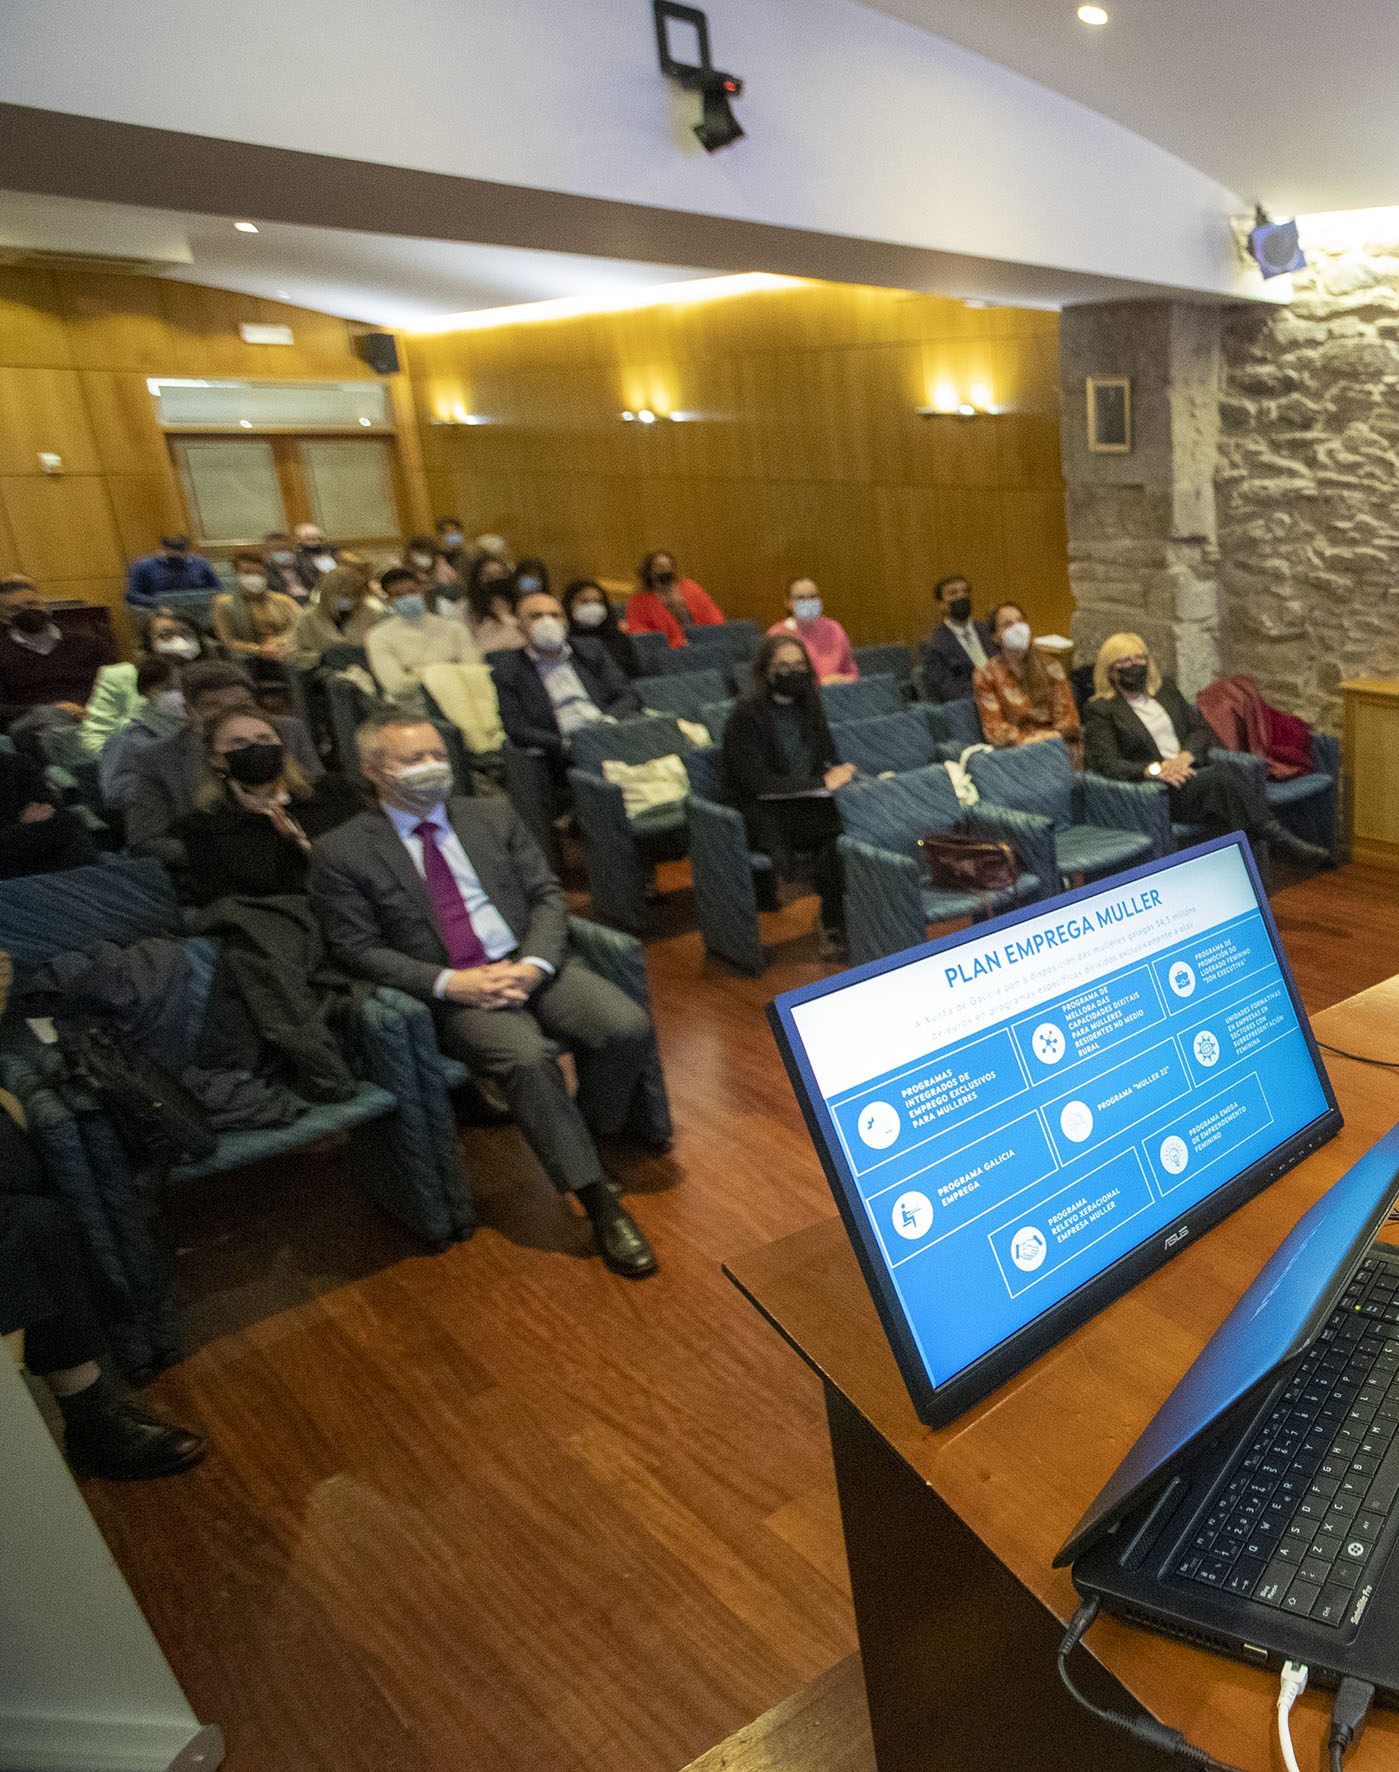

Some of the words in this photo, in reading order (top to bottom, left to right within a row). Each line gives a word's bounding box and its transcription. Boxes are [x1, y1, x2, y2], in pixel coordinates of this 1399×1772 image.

[944, 950, 1001, 988] PLAN
[1004, 915, 1095, 972] EMPREGA
[1095, 888, 1162, 929] MULLER
[1194, 943, 1224, 960] PROGRAMA
[1223, 939, 1232, 948] DE
[1197, 950, 1229, 968] PROMOCIÓN
[1228, 945, 1237, 954] DO
[1200, 959, 1227, 977] LIDERADO
[1226, 947, 1251, 964] FEMININO
[1061, 990, 1099, 1012] PROGRAMA
[1099, 986, 1109, 995] DE
[1065, 1003, 1096, 1021] MELLORA
[1096, 995, 1110, 1006] DAS
[1068, 1006, 1113, 1030] CAPACIDADES
[1113, 991, 1140, 1009] DIXITAIS
[1224, 1006, 1250, 1025] UNIDADES
[1250, 990, 1281, 1010] FORMATIVAS
[1071, 1025, 1090, 1040] PARA
[1090, 1010, 1123, 1031] MULLERES
[1074, 1024, 1114, 1049] RESIDENTES
[1113, 1018, 1124, 1030] NO
[1124, 1009, 1144, 1024] MEDIO
[1227, 1024, 1236, 1033] EN
[1235, 1010, 1261, 1029] EMPRESAS
[1261, 1006, 1269, 1014] EN
[1230, 1022, 1256, 1041] SECTORES
[1255, 1015, 1267, 1026] CON
[1077, 1042, 1100, 1057] RURAL
[1235, 1038, 1261, 1056] FEMININA
[901, 1068, 953, 1098] PROGRAMAS
[905, 1078, 958, 1109] INTEGRADOS
[958, 1072, 970, 1083] DE
[908, 1094, 948, 1119] EMPREGO
[949, 1070, 997, 1098] EXCLUSIVOS
[912, 1112, 936, 1129] PARA
[936, 1091, 978, 1118] MULLERES
[1097, 1088, 1133, 1112] PROGRAMA
[1188, 1114, 1220, 1137] PROGRAMA
[1219, 1102, 1239, 1117] EMEGA
[1191, 1136, 1201, 1145] DE
[1200, 1105, 1247, 1140] EMPRENDEMENTO
[1194, 1131, 1222, 1153] FEMININO
[937, 1167, 984, 1198] PROGRAMA
[983, 1149, 1016, 1172] GALICIA
[941, 1180, 981, 1207] EMPREGA
[1048, 1197, 1088, 1226] PROGRAMA
[1051, 1213, 1079, 1236] RELEVO
[1079, 1187, 1121, 1219] XERACIONAL
[1056, 1219, 1090, 1244] EMPRESA
[1089, 1200, 1117, 1222] MULLER
[1164, 1225, 1189, 1250] ASUS
[1362, 1444, 1372, 1452] N
[1322, 1465, 1332, 1473] G
[1312, 1485, 1321, 1493] F
[1271, 1502, 1282, 1510] E
[1301, 1505, 1311, 1513] D
[1334, 1503, 1344, 1511] C
[1260, 1521, 1271, 1530] W
[1290, 1526, 1301, 1534] S
[1323, 1523, 1334, 1532] X
[1248, 1544, 1259, 1553] Q
[1312, 1545, 1323, 1553] Z
[1362, 1585, 1372, 1597] Pro
